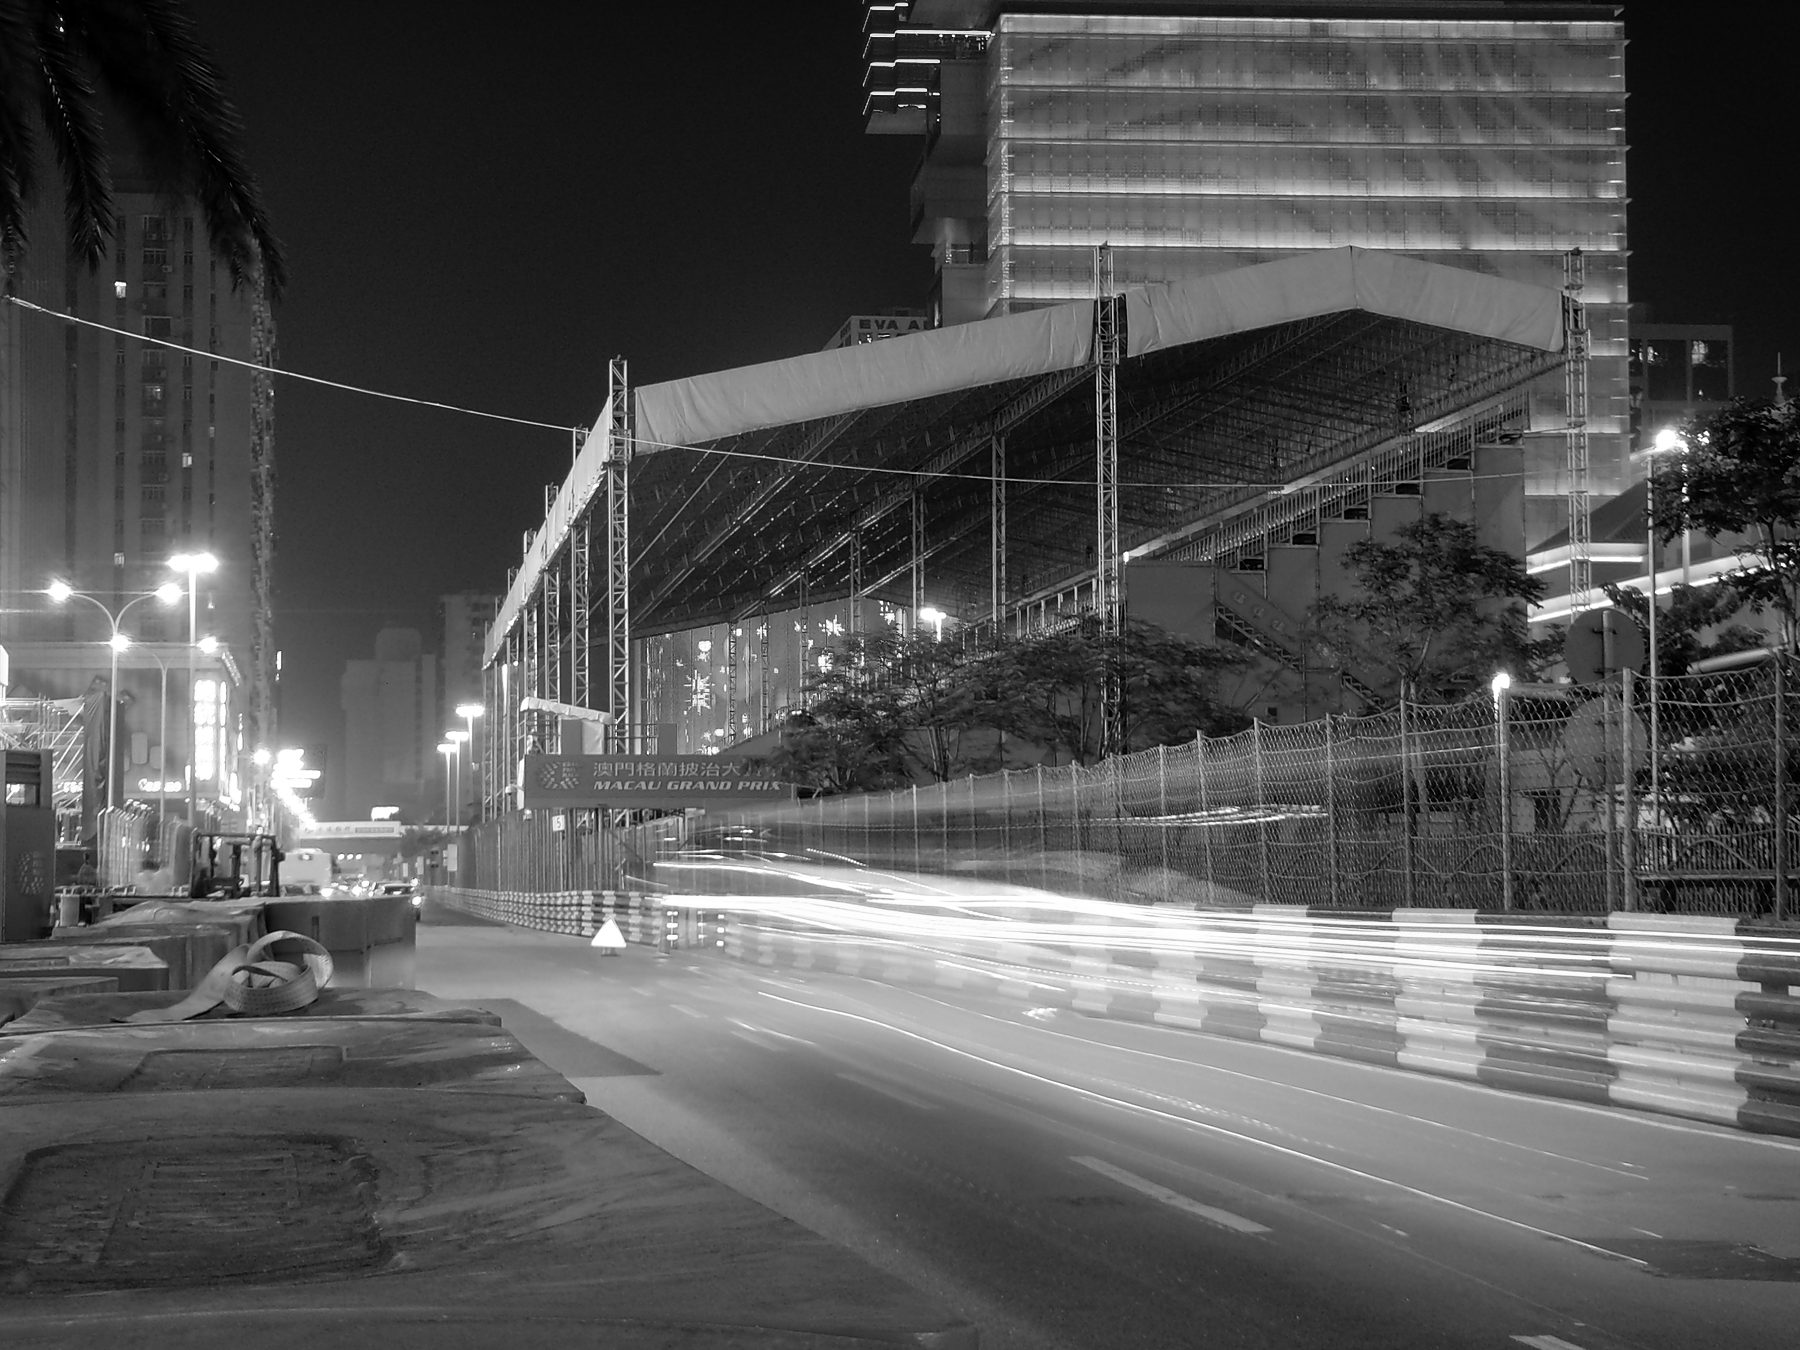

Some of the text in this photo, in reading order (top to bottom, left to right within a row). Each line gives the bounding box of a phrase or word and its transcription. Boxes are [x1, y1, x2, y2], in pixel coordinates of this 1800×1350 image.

[859, 319, 898, 330] EVA
[593, 780, 781, 791] MACAU GRAND PRIX
